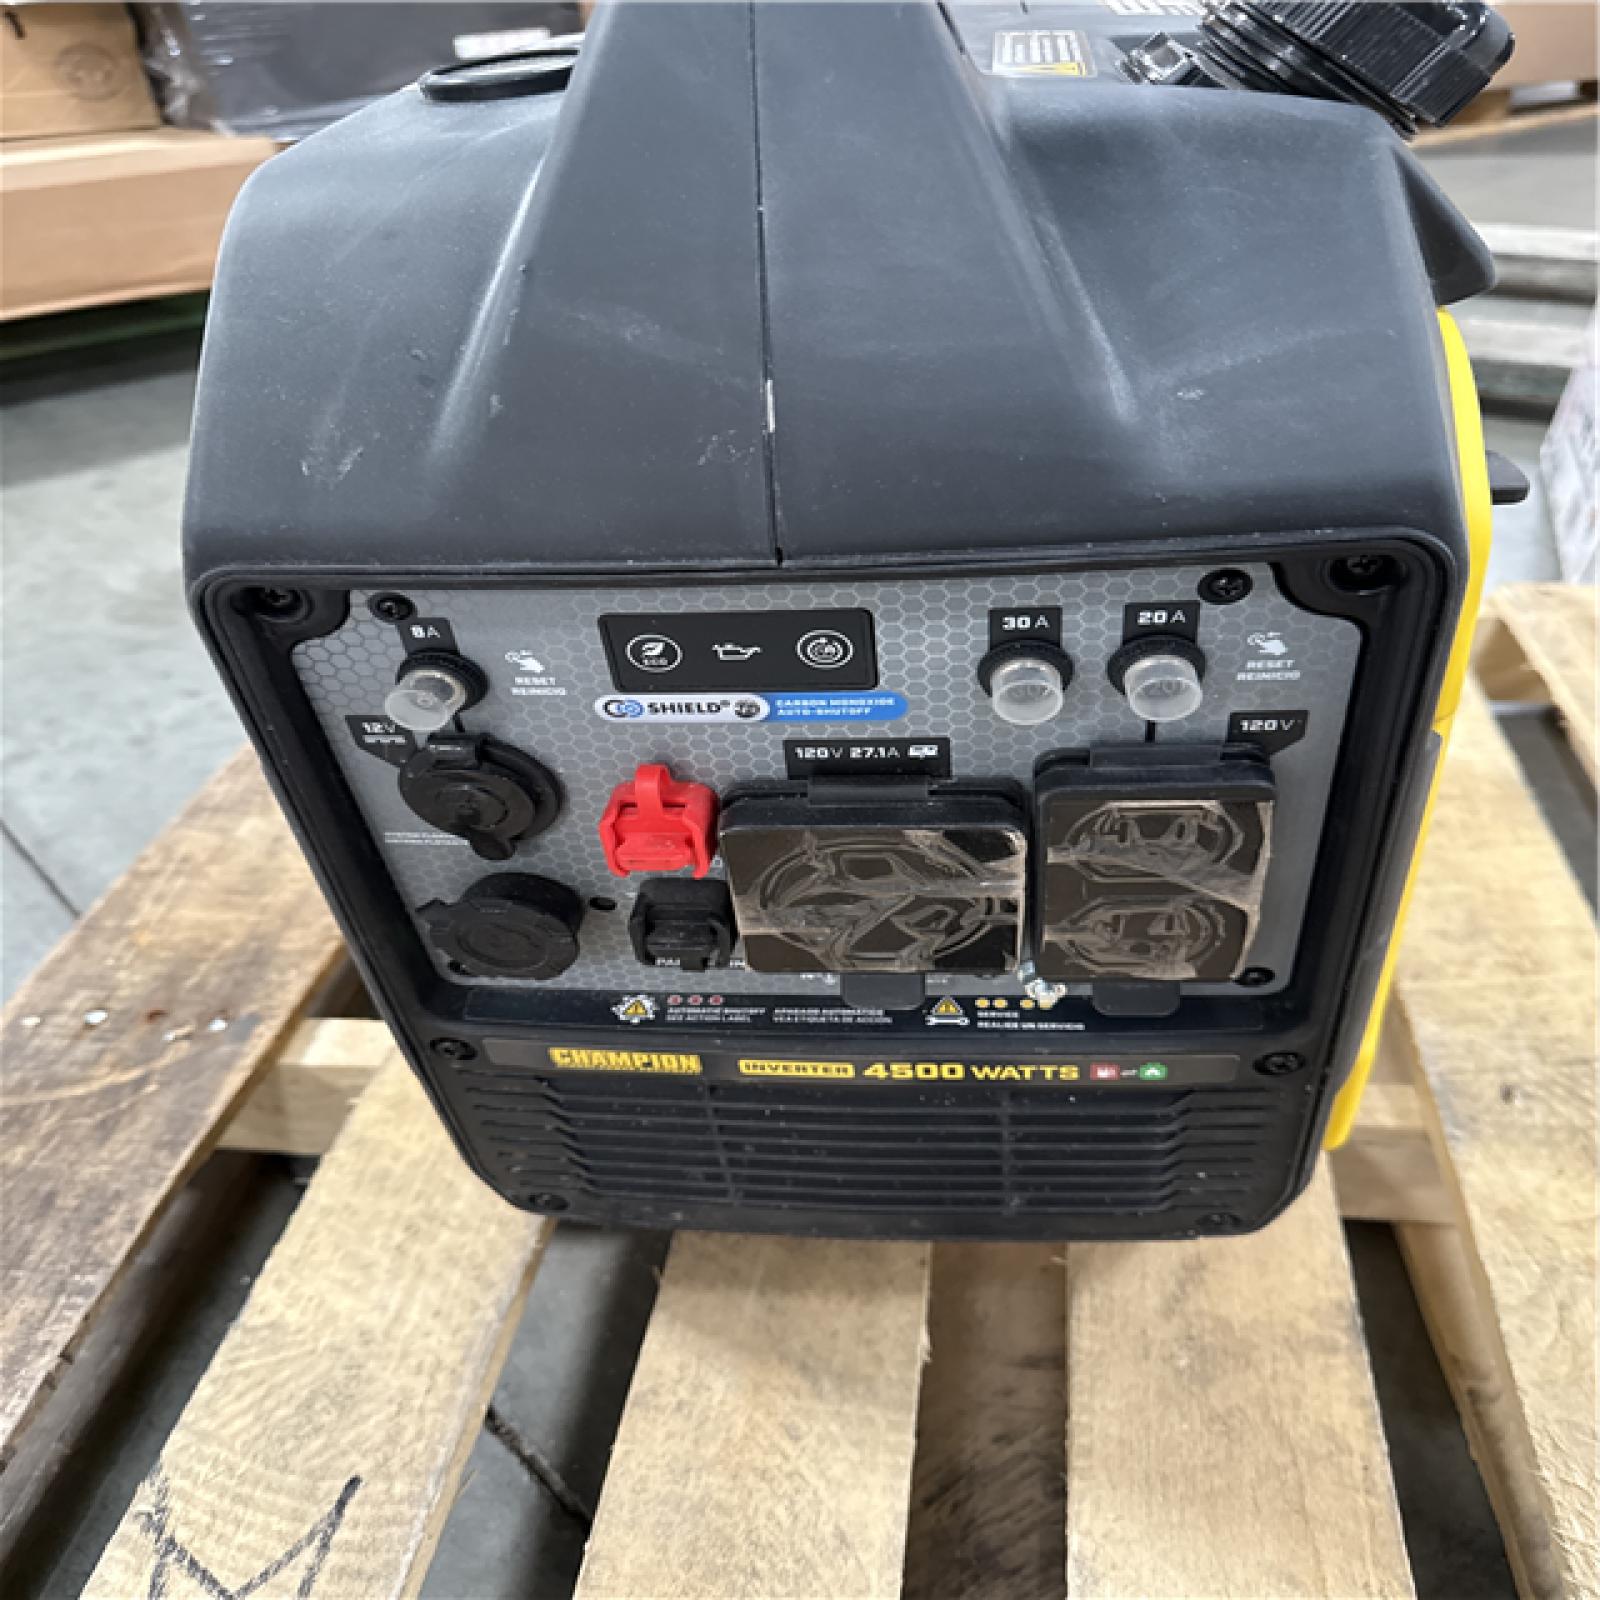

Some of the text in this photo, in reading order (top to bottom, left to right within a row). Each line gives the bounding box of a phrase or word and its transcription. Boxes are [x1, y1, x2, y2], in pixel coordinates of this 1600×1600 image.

[1136, 611, 1166, 624] 20
[1245, 660, 1296, 669] RESET
[514, 676, 556, 686] RESET
[776, 697, 896, 707] CARBON MONOXIDE
[1239, 718, 1296, 732] 120V
[794, 746, 901, 759] 120V 27.1A
[549, 1047, 703, 1076] CHAMPION
[741, 1060, 1081, 1081] INVERTER 4500 WATTS
